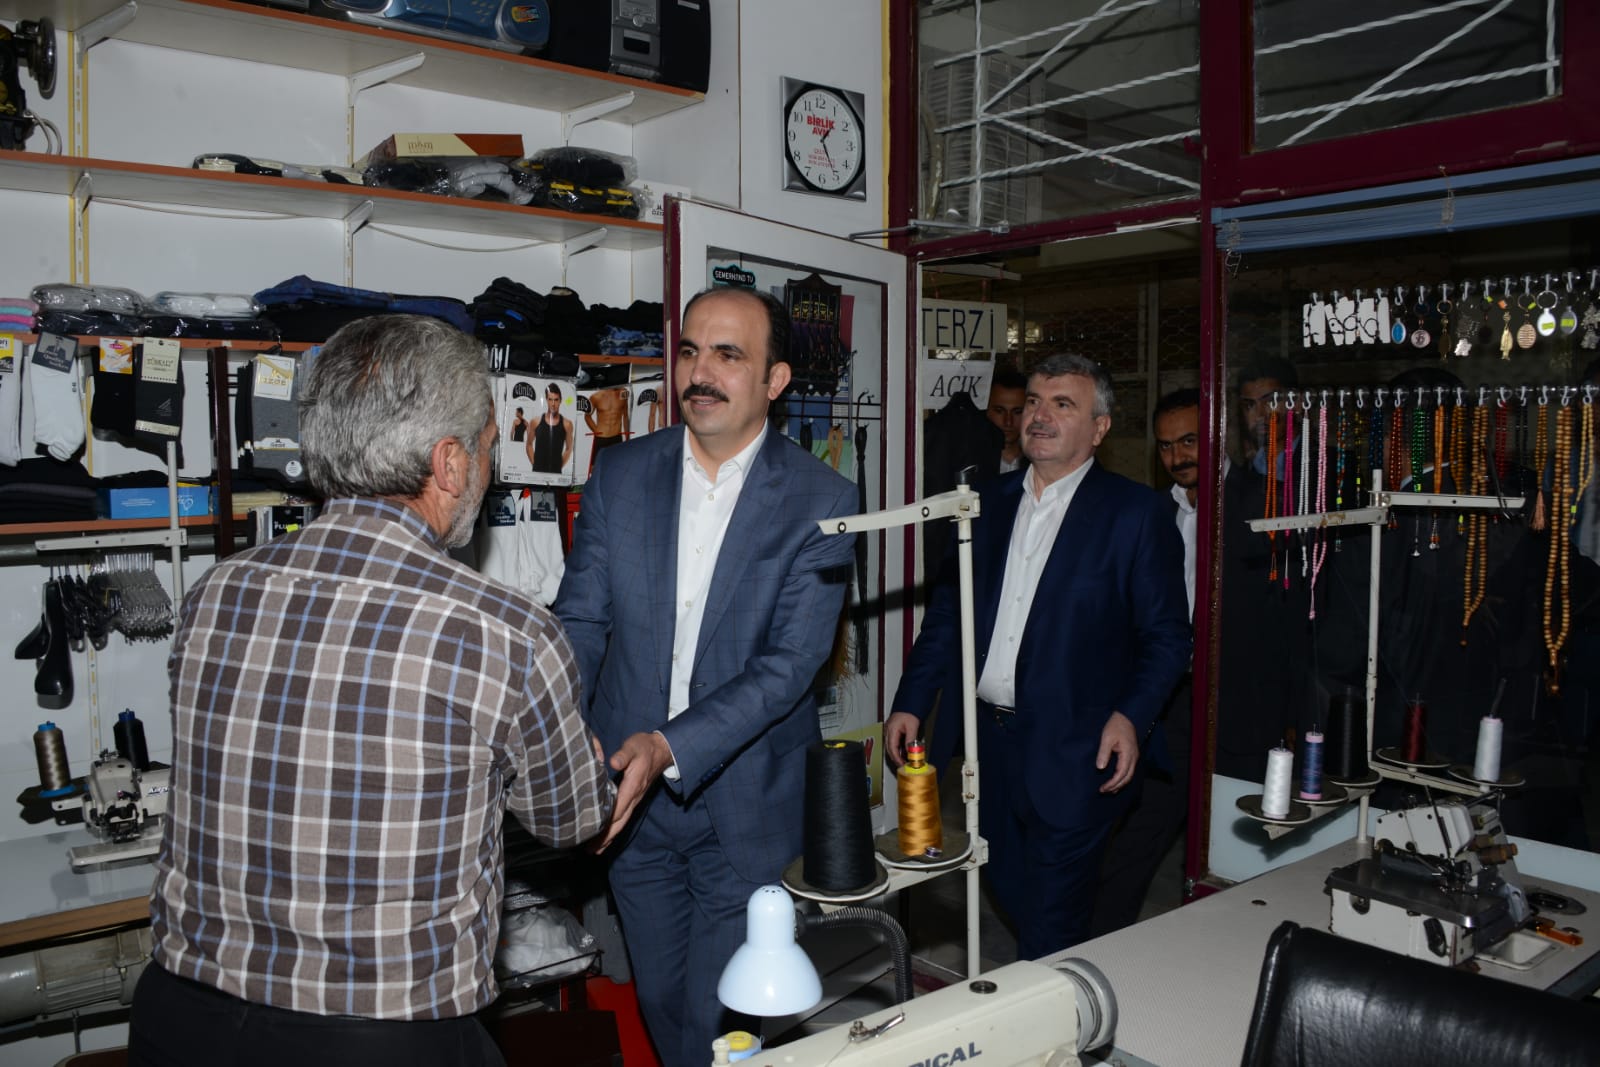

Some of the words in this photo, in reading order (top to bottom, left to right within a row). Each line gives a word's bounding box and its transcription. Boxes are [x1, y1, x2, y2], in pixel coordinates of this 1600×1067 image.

[804, 100, 811, 112] 11
[816, 97, 826, 109] 12
[794, 112, 803, 123] 10
[807, 114, 835, 130] BİRLİK
[842, 121, 849, 132] 2
[788, 130, 796, 141] 9
[846, 140, 853, 152] 3
[794, 150, 801, 161] 8
[804, 166, 811, 177] 7
[832, 170, 840, 181] 5
[818, 174, 826, 185] 6
